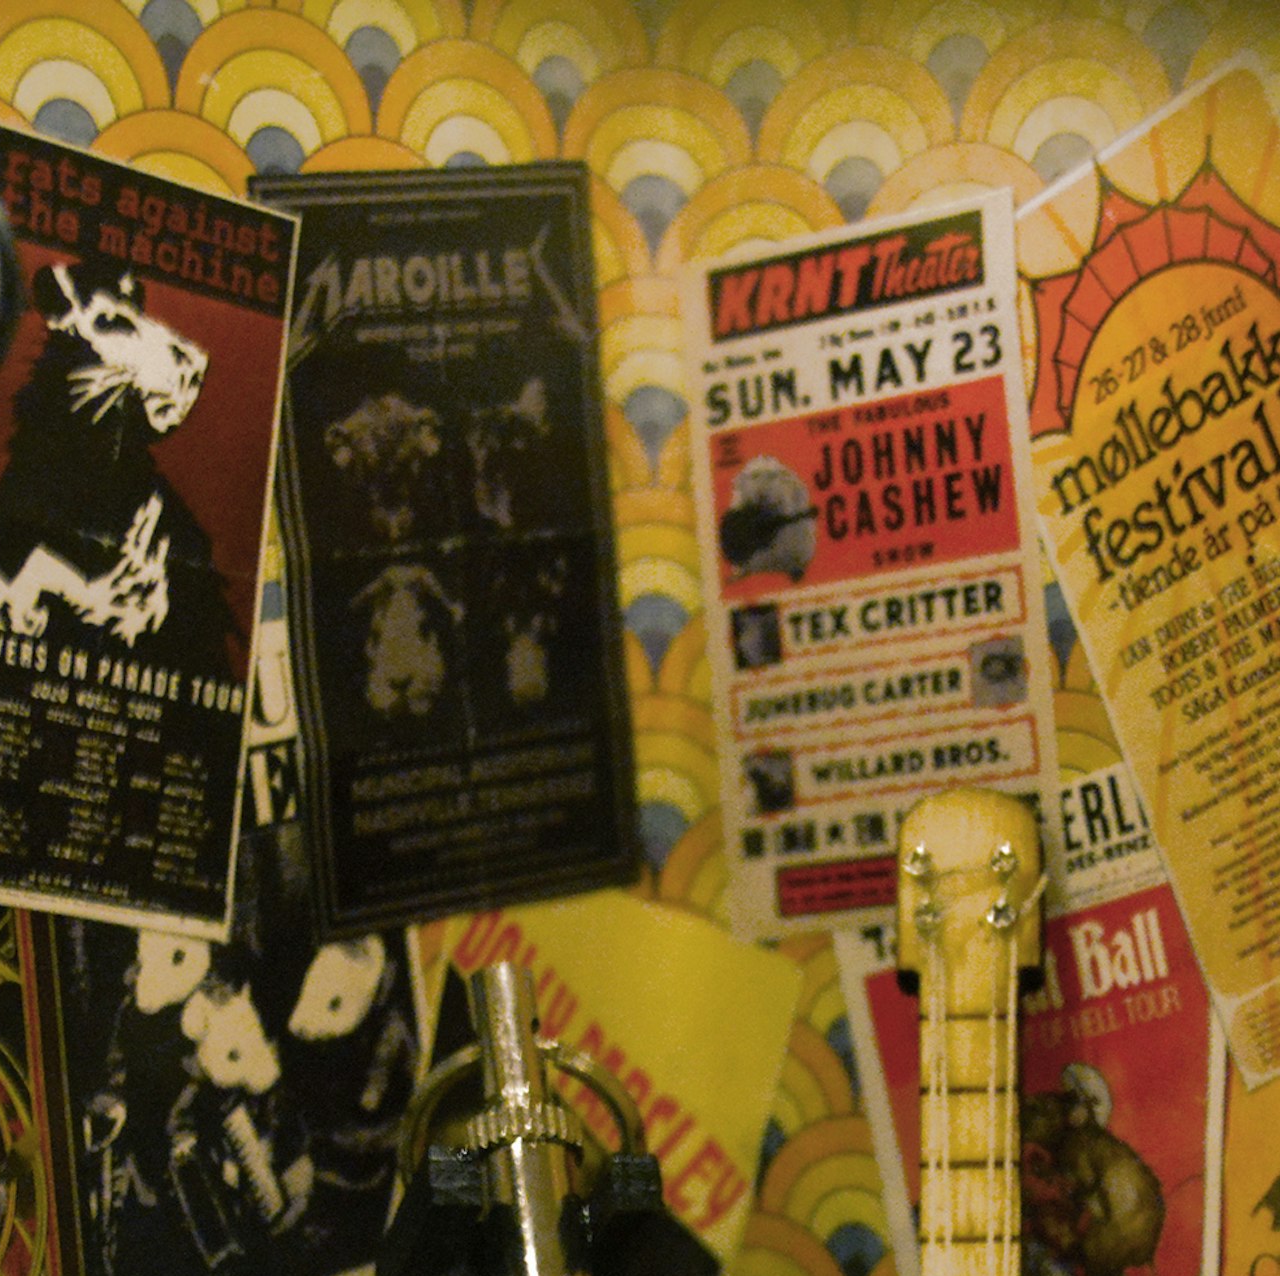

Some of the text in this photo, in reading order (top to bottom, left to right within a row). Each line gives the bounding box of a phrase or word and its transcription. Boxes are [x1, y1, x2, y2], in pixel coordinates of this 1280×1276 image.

[3, 186, 281, 301] the machine
[117, 186, 281, 263] against
[718, 246, 871, 336] KRNT
[1169, 313, 1202, 353] 28
[705, 368, 812, 428] SUN.
[828, 339, 933, 400] MAY
[951, 323, 1003, 375] 23
[814, 412, 987, 492] JOHNNY
[824, 463, 1003, 542] CASHEW
[788, 580, 1004, 646] TEX CRITTER
[58, 645, 89, 681] ON
[97, 656, 179, 701] PARADE
[191, 675, 246, 715] TOUR
[863, 667, 963, 706] CARTER
[811, 749, 925, 784] WILLARD
[1069, 906, 1171, 1001] Ball
[1124, 984, 1184, 1024] TOUR
